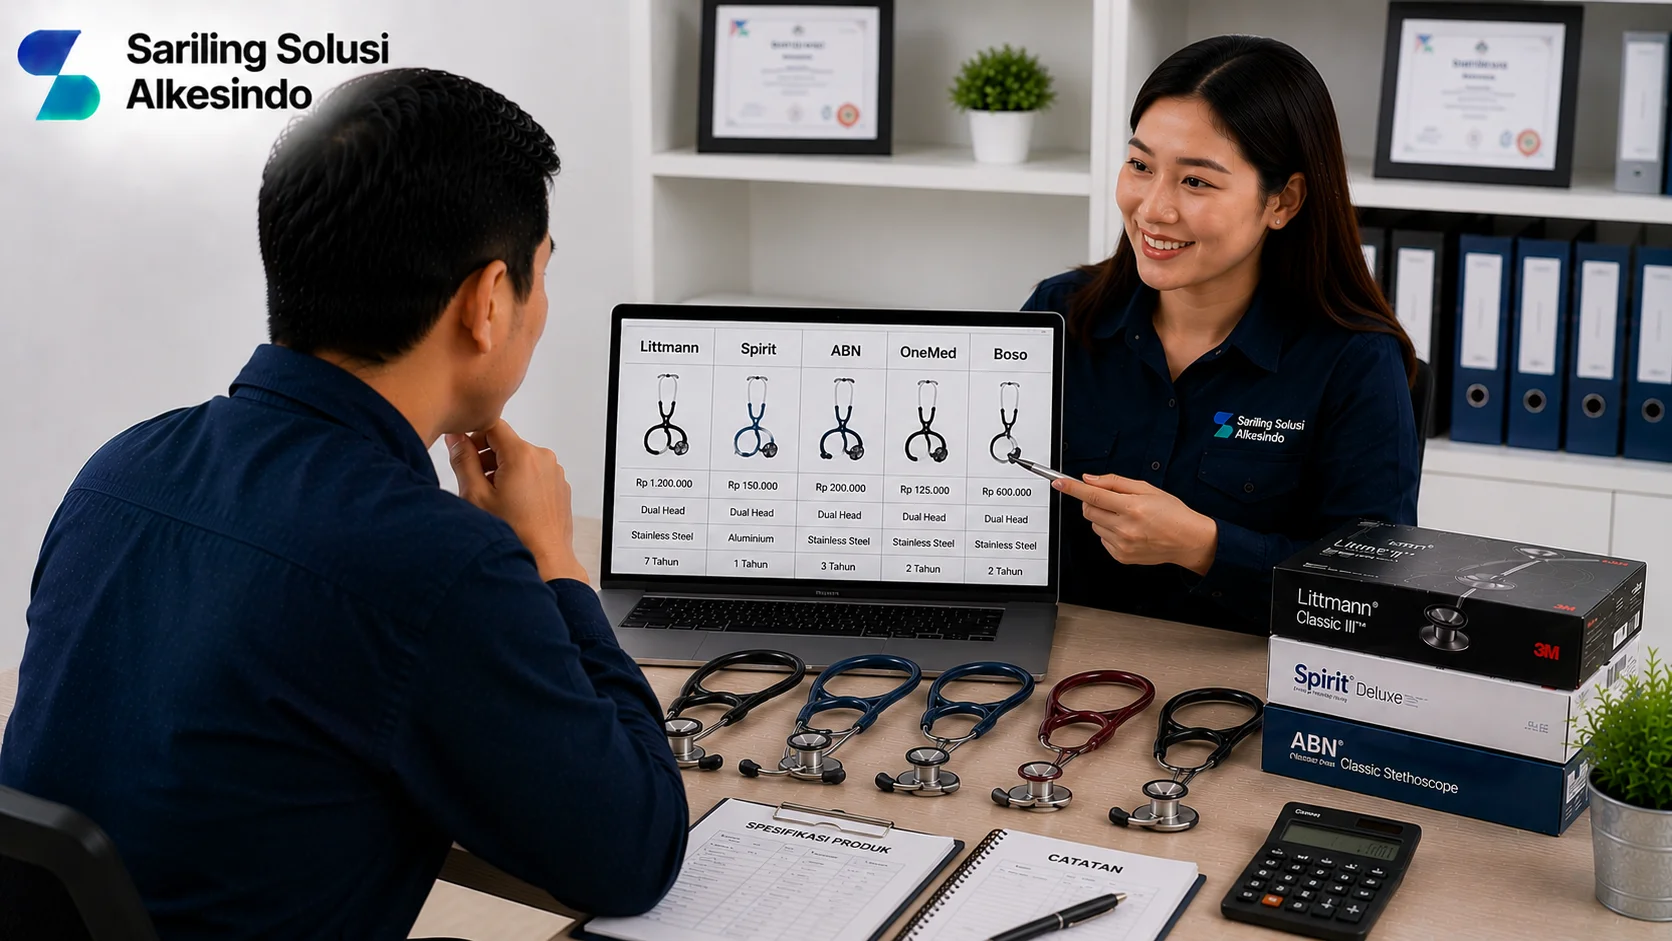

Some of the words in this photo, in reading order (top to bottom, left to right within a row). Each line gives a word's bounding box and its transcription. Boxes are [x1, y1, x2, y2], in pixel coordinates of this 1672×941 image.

[641, 340, 699, 353] Littmann
[741, 342, 777, 357] Spirit
[831, 345, 861, 357] ABN
[900, 346, 956, 359] OneMed
[994, 348, 1028, 360] Boso
[1237, 415, 1273, 431] Sariling
[1275, 418, 1306, 431] Solusi
[1235, 428, 1285, 443] Alkesindo
[636, 478, 648, 488] Rp
[650, 478, 693, 488] 1.200.000
[728, 480, 740, 491] Rp
[743, 481, 778, 490] 150.000
[816, 483, 828, 493] Rp
[830, 483, 866, 492] 200.000
[900, 485, 912, 495] Rp
[914, 486, 950, 495] 125.000
[983, 487, 994, 497] Rp
[996, 488, 1031, 497] 600.000
[641, 506, 660, 514] Dual
[663, 506, 685, 515] Head
[730, 508, 749, 516] Dual
[751, 509, 774, 517] Head
[818, 510, 837, 519] Dual
[839, 511, 861, 519] Head
[903, 512, 922, 521] Dual
[924, 513, 946, 522] Head
[985, 515, 1003, 523] Dual
[1006, 515, 1028, 524] Head
[631, 531, 670, 540] Stainless
[672, 532, 693, 541] Steel
[728, 534, 774, 543] Aluminium
[808, 535, 847, 545] Stainless
[849, 537, 870, 545] Steel
[893, 538, 931, 547] Stainless
[933, 539, 955, 548] Steel
[975, 540, 1013, 549] Stainless
[1015, 541, 1037, 550] Steel
[645, 557, 650, 565] 7
[652, 557, 679, 566] Tahun
[734, 559, 738, 567] 1
[741, 559, 768, 568] Tahun
[821, 562, 826, 570] 3
[829, 562, 855, 571] Tahun
[906, 564, 912, 572] 2
[914, 564, 940, 573] Tahun
[988, 567, 994, 575] 2
[996, 567, 1023, 575] Tahun
[1296, 610, 1342, 631] Classic
[1533, 642, 1560, 660] 3M
[1356, 682, 1403, 705] Deluxe
[1340, 757, 1381, 778] Classic
[1383, 767, 1459, 794] Stethoscope
[745, 821, 831, 844] SPESIFIKASI
[831, 837, 892, 855] PRODUK
[1047, 853, 1124, 874] CATATAN
